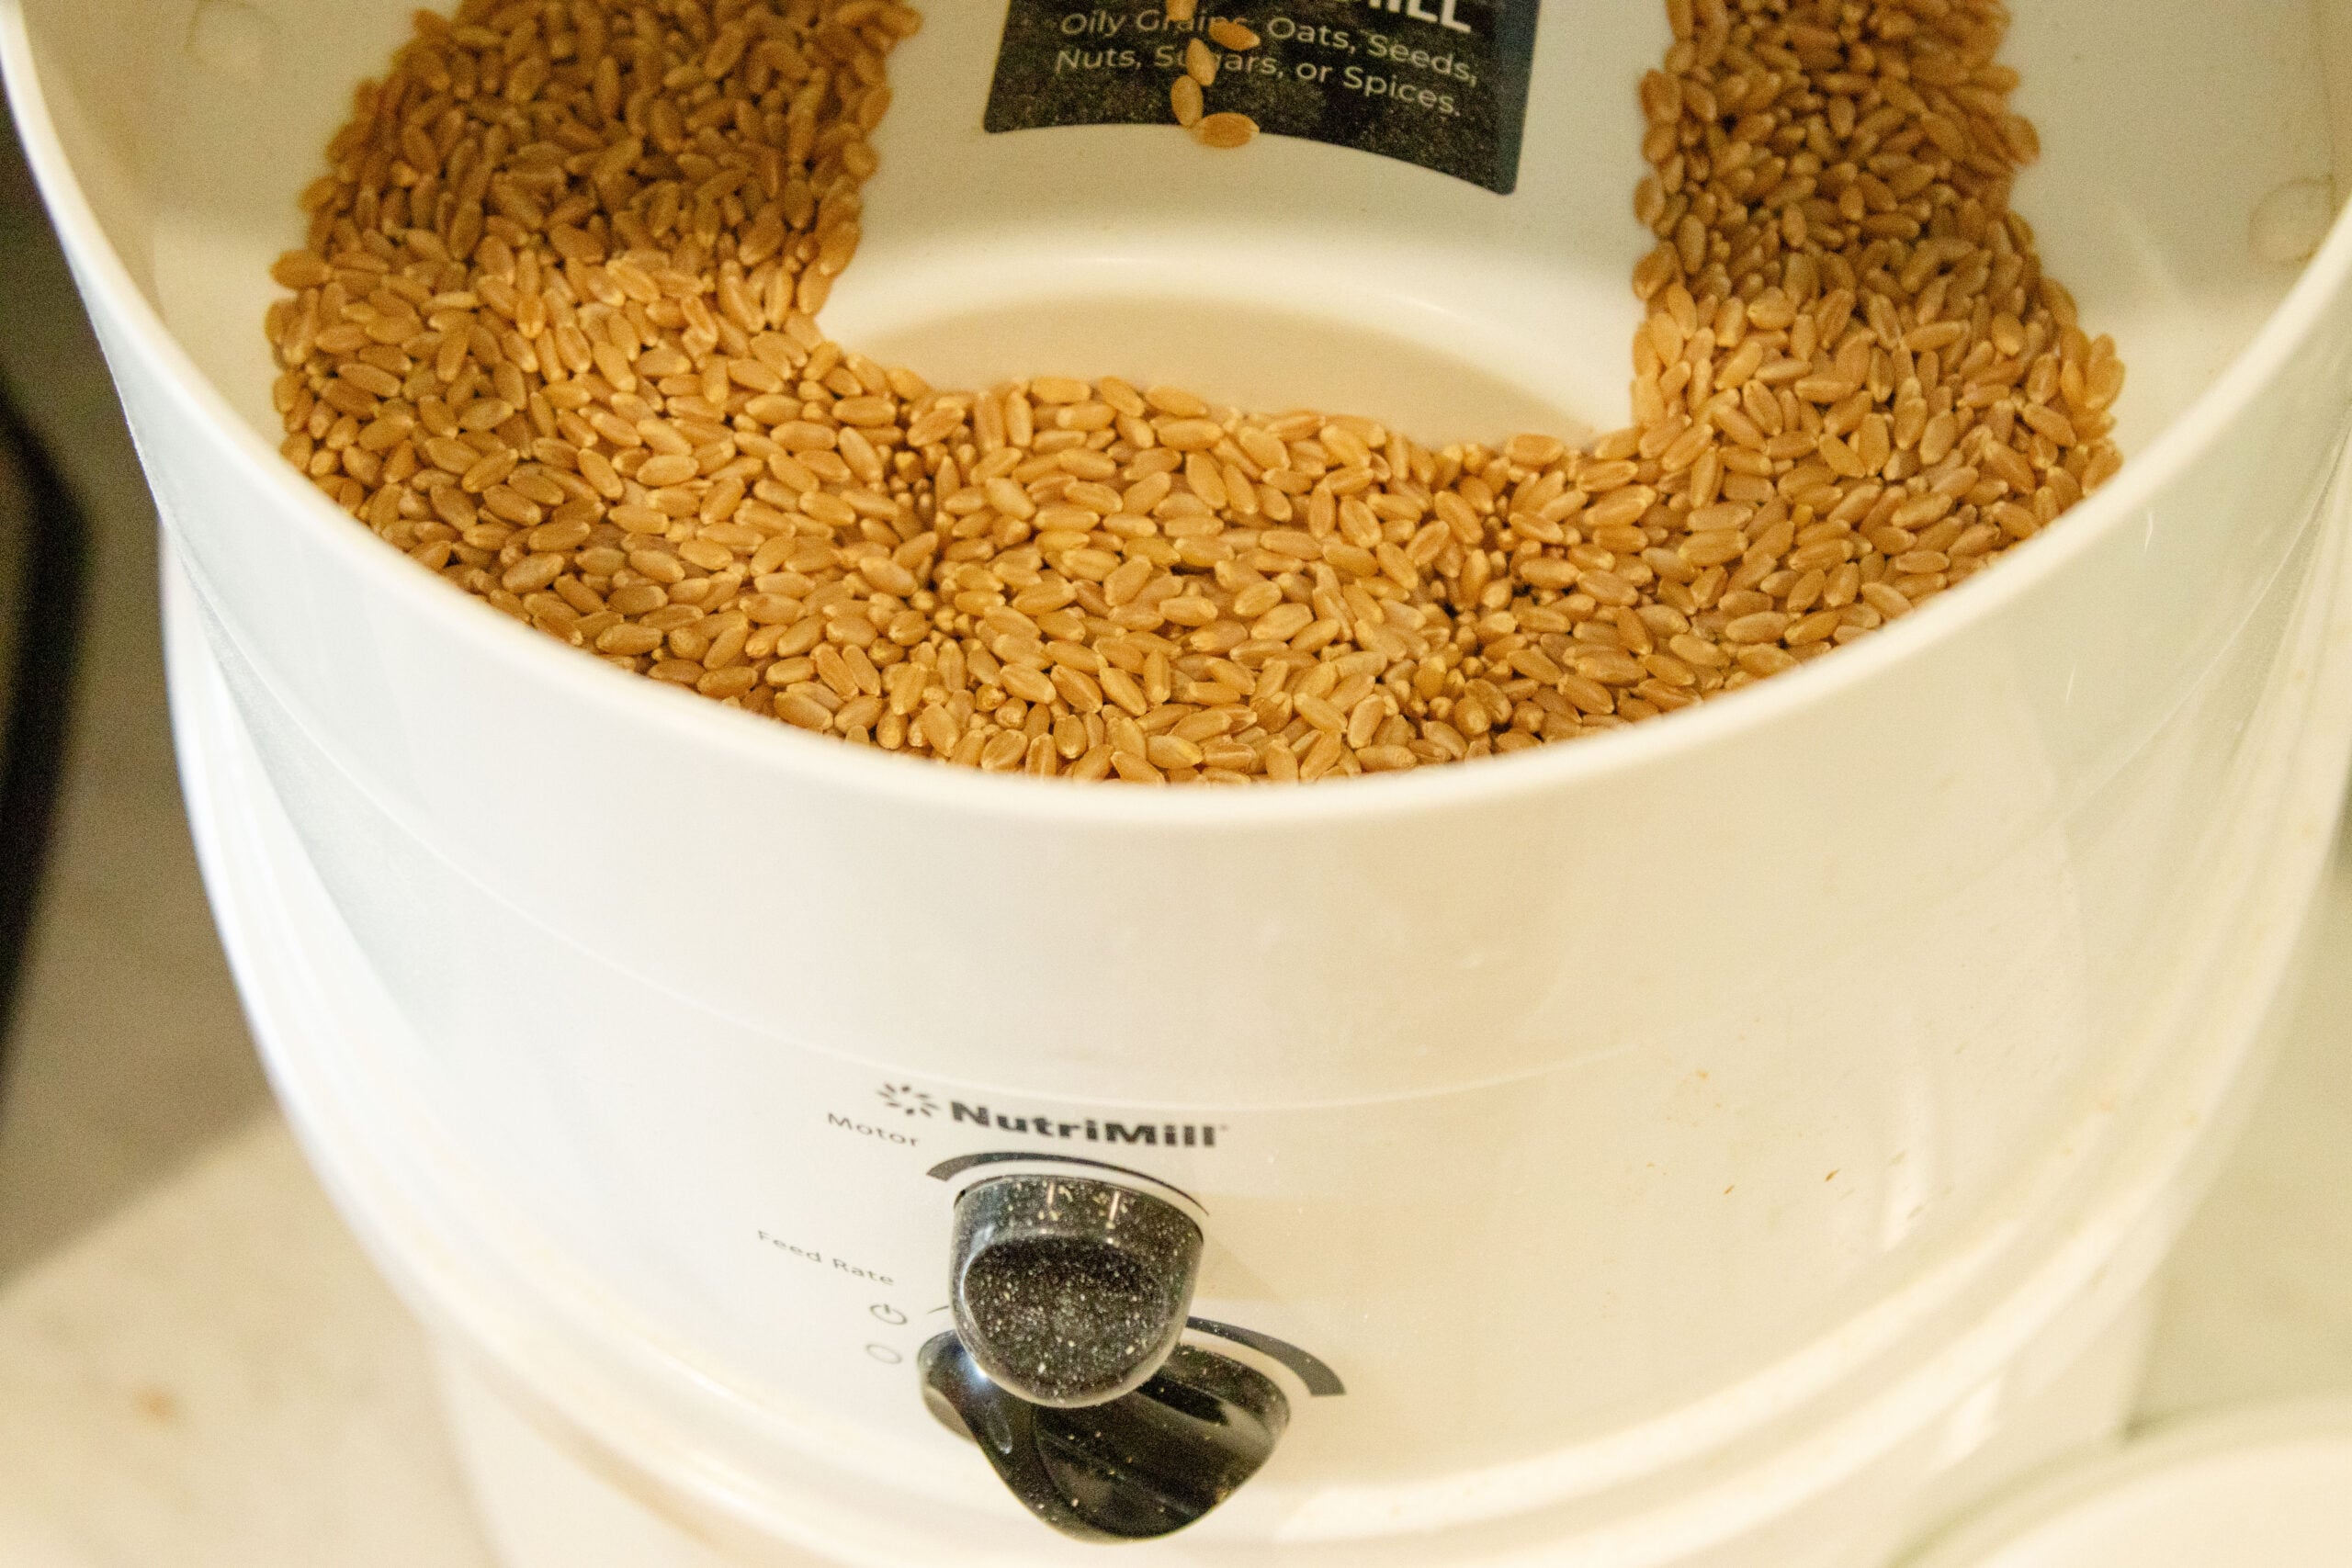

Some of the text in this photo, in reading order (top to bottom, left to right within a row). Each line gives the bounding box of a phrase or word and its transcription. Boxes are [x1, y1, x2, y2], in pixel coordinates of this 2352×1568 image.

[1352, 0, 1472, 34] LL
[1061, 9, 1476, 87] Oily Grai Oats, Seeds,
[1056, 45, 1461, 117] Nuts, Suars, or Spices.
[828, 1112, 919, 1147] Motor
[950, 1100, 1216, 1147] NutriMill
[758, 1230, 894, 1286] Feed Rate
